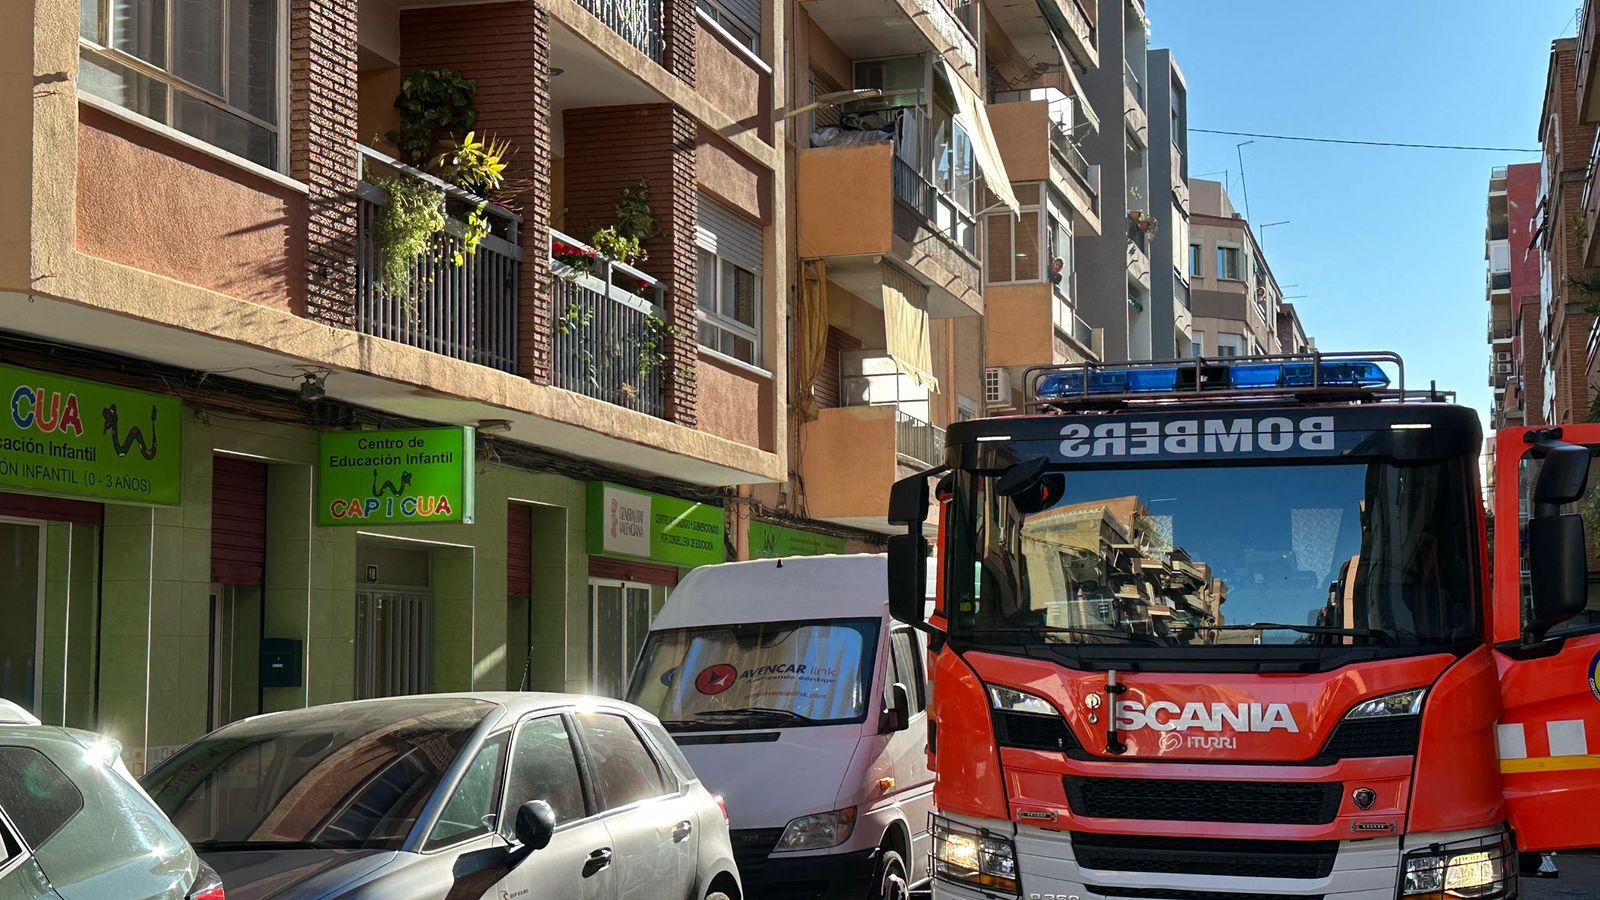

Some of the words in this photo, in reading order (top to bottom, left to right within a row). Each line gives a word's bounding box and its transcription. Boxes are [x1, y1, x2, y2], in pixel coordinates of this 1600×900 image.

[0, 436, 44, 455] ación
[49, 440, 97, 462] Infantil
[358, 438, 404, 450] Centro
[408, 436, 425, 448] de
[330, 453, 401, 467] Educación
[406, 452, 453, 465] Infantil
[22, 465, 79, 484] INFANTIL
[115, 474, 151, 493] AÑOS)
[739, 663, 807, 680] AVENCAR
[811, 666, 836, 677] link
[1115, 700, 1299, 732] SCANIA
[1187, 736, 1236, 749] ITURRI
